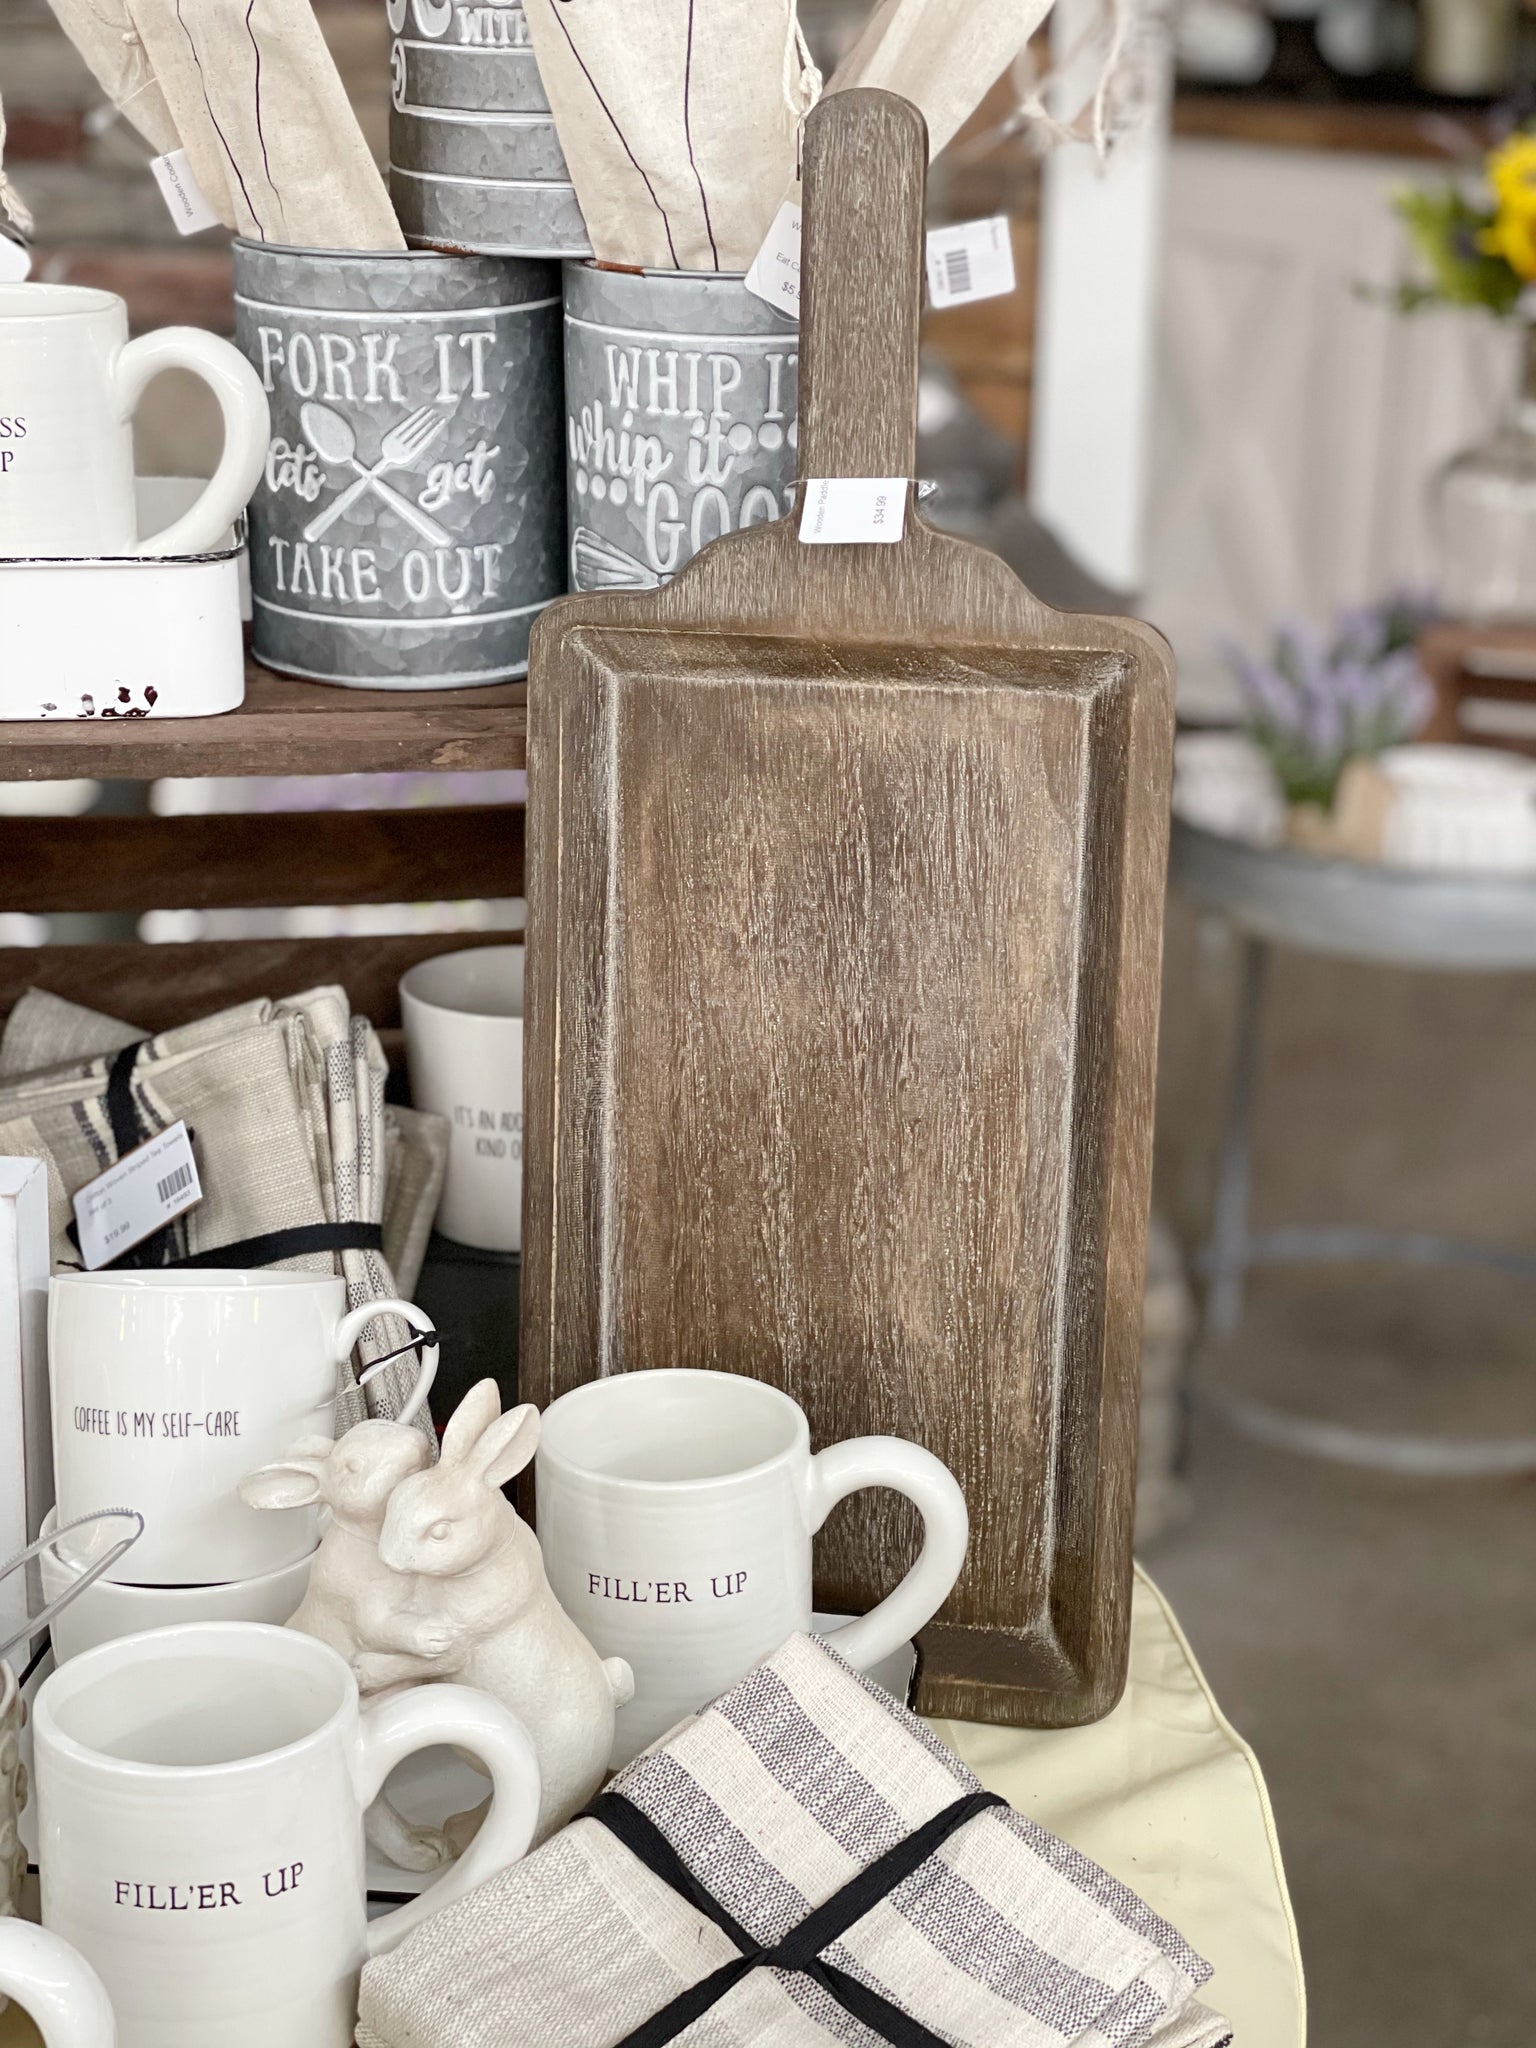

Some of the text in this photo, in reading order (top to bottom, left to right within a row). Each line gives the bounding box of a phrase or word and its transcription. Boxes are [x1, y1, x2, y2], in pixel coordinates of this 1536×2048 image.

[175, 183, 194, 218] Wooden
[776, 252, 791, 267] Eat
[258, 326, 497, 402] FORK IT
[604, 345, 742, 418] WHIP
[569, 399, 674, 506] whip
[418, 440, 501, 513] get
[813, 480, 829, 534] Wooden Paddle
[872, 495, 887, 525] $34.99
[269, 535, 503, 602] TAKE OUT
[478, 1109, 496, 1131] AN
[476, 1136, 507, 1158] KIND
[104, 1220, 130, 1244] $19.99
[74, 1406, 241, 1438] COFFEE IS MY SELF-CARE
[588, 1571, 748, 1603] FILL'ER UP
[114, 1861, 304, 1911] FILL'ER UP
